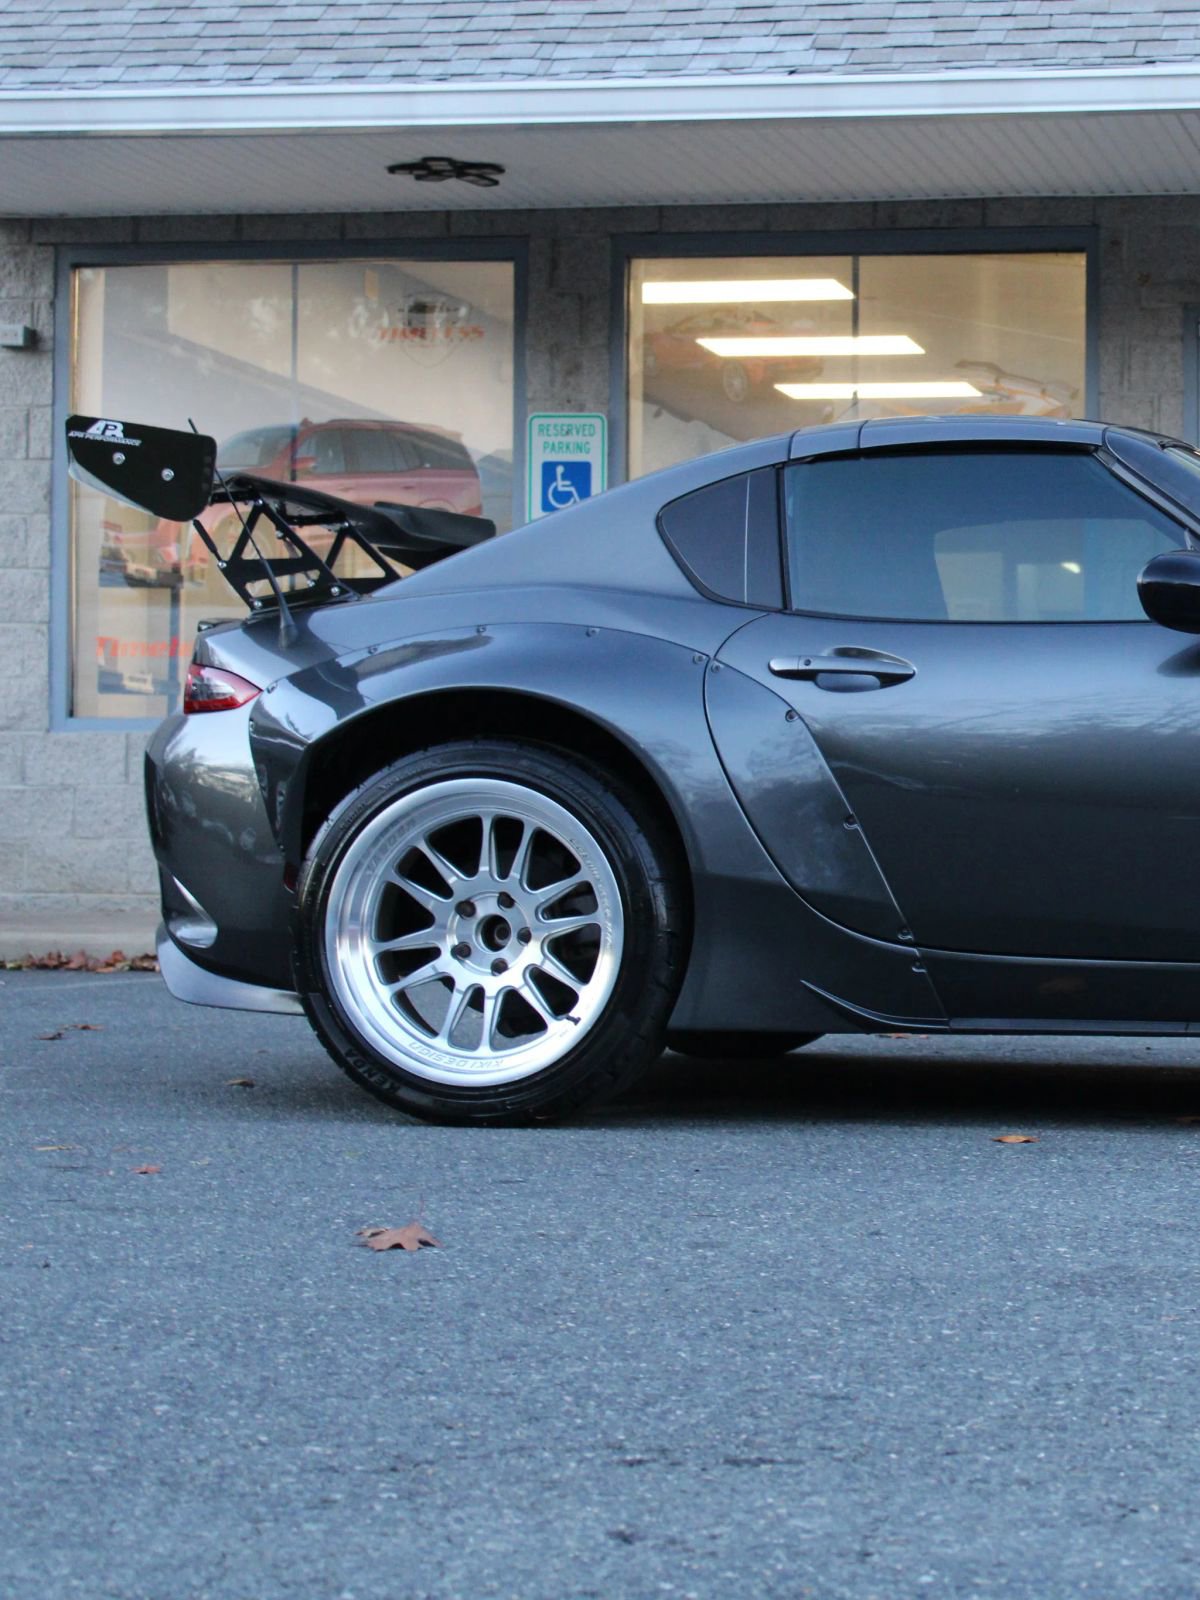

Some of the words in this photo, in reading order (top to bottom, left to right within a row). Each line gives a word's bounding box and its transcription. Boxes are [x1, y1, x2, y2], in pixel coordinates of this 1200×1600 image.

[86, 419, 124, 438] APR
[537, 423, 596, 438] RESERVED
[84, 432, 142, 447] PERFORMANCE
[543, 441, 592, 455] PARKING
[343, 1047, 401, 1095] KENDA
